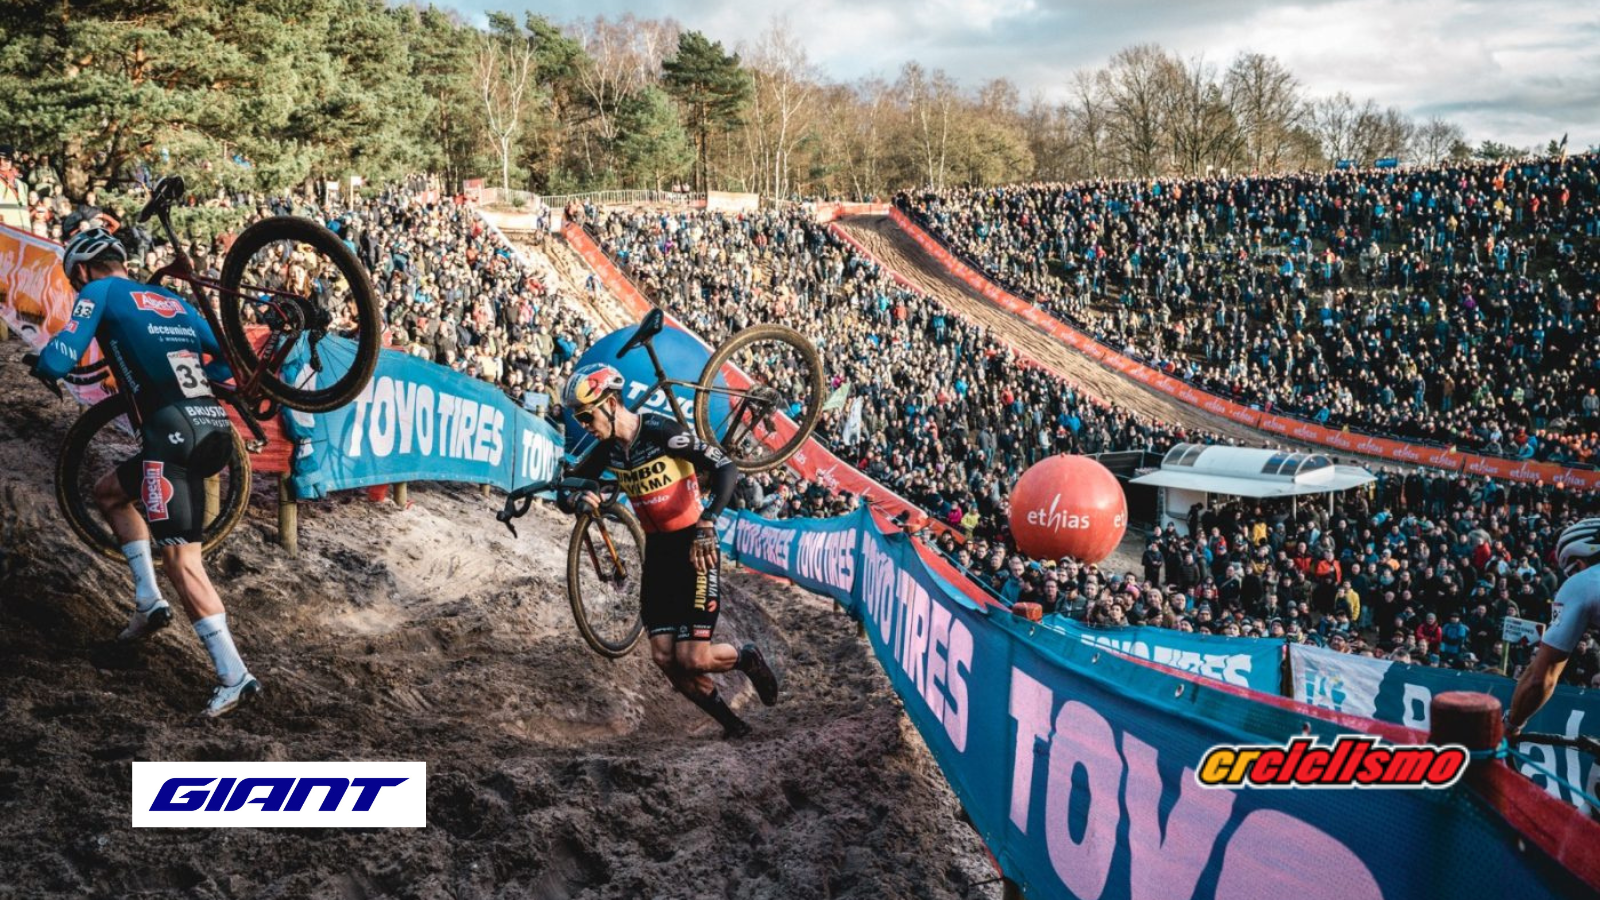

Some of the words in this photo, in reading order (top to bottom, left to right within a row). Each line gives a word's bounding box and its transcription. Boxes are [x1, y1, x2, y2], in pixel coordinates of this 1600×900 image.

[73, 303, 92, 317] 33
[347, 374, 435, 458] TOYO
[436, 390, 506, 467] TIRES
[1392, 443, 1420, 460] ethias
[626, 473, 672, 495] VISMA
[1509, 462, 1541, 480] ethias
[1552, 468, 1586, 487] ethias
[148, 468, 161, 514] Alpecin
[1027, 493, 1090, 534] ethias
[797, 530, 827, 581] TOYO
[825, 527, 857, 593] TIRES
[861, 530, 896, 645] TOYO
[894, 569, 975, 754] TIRES
